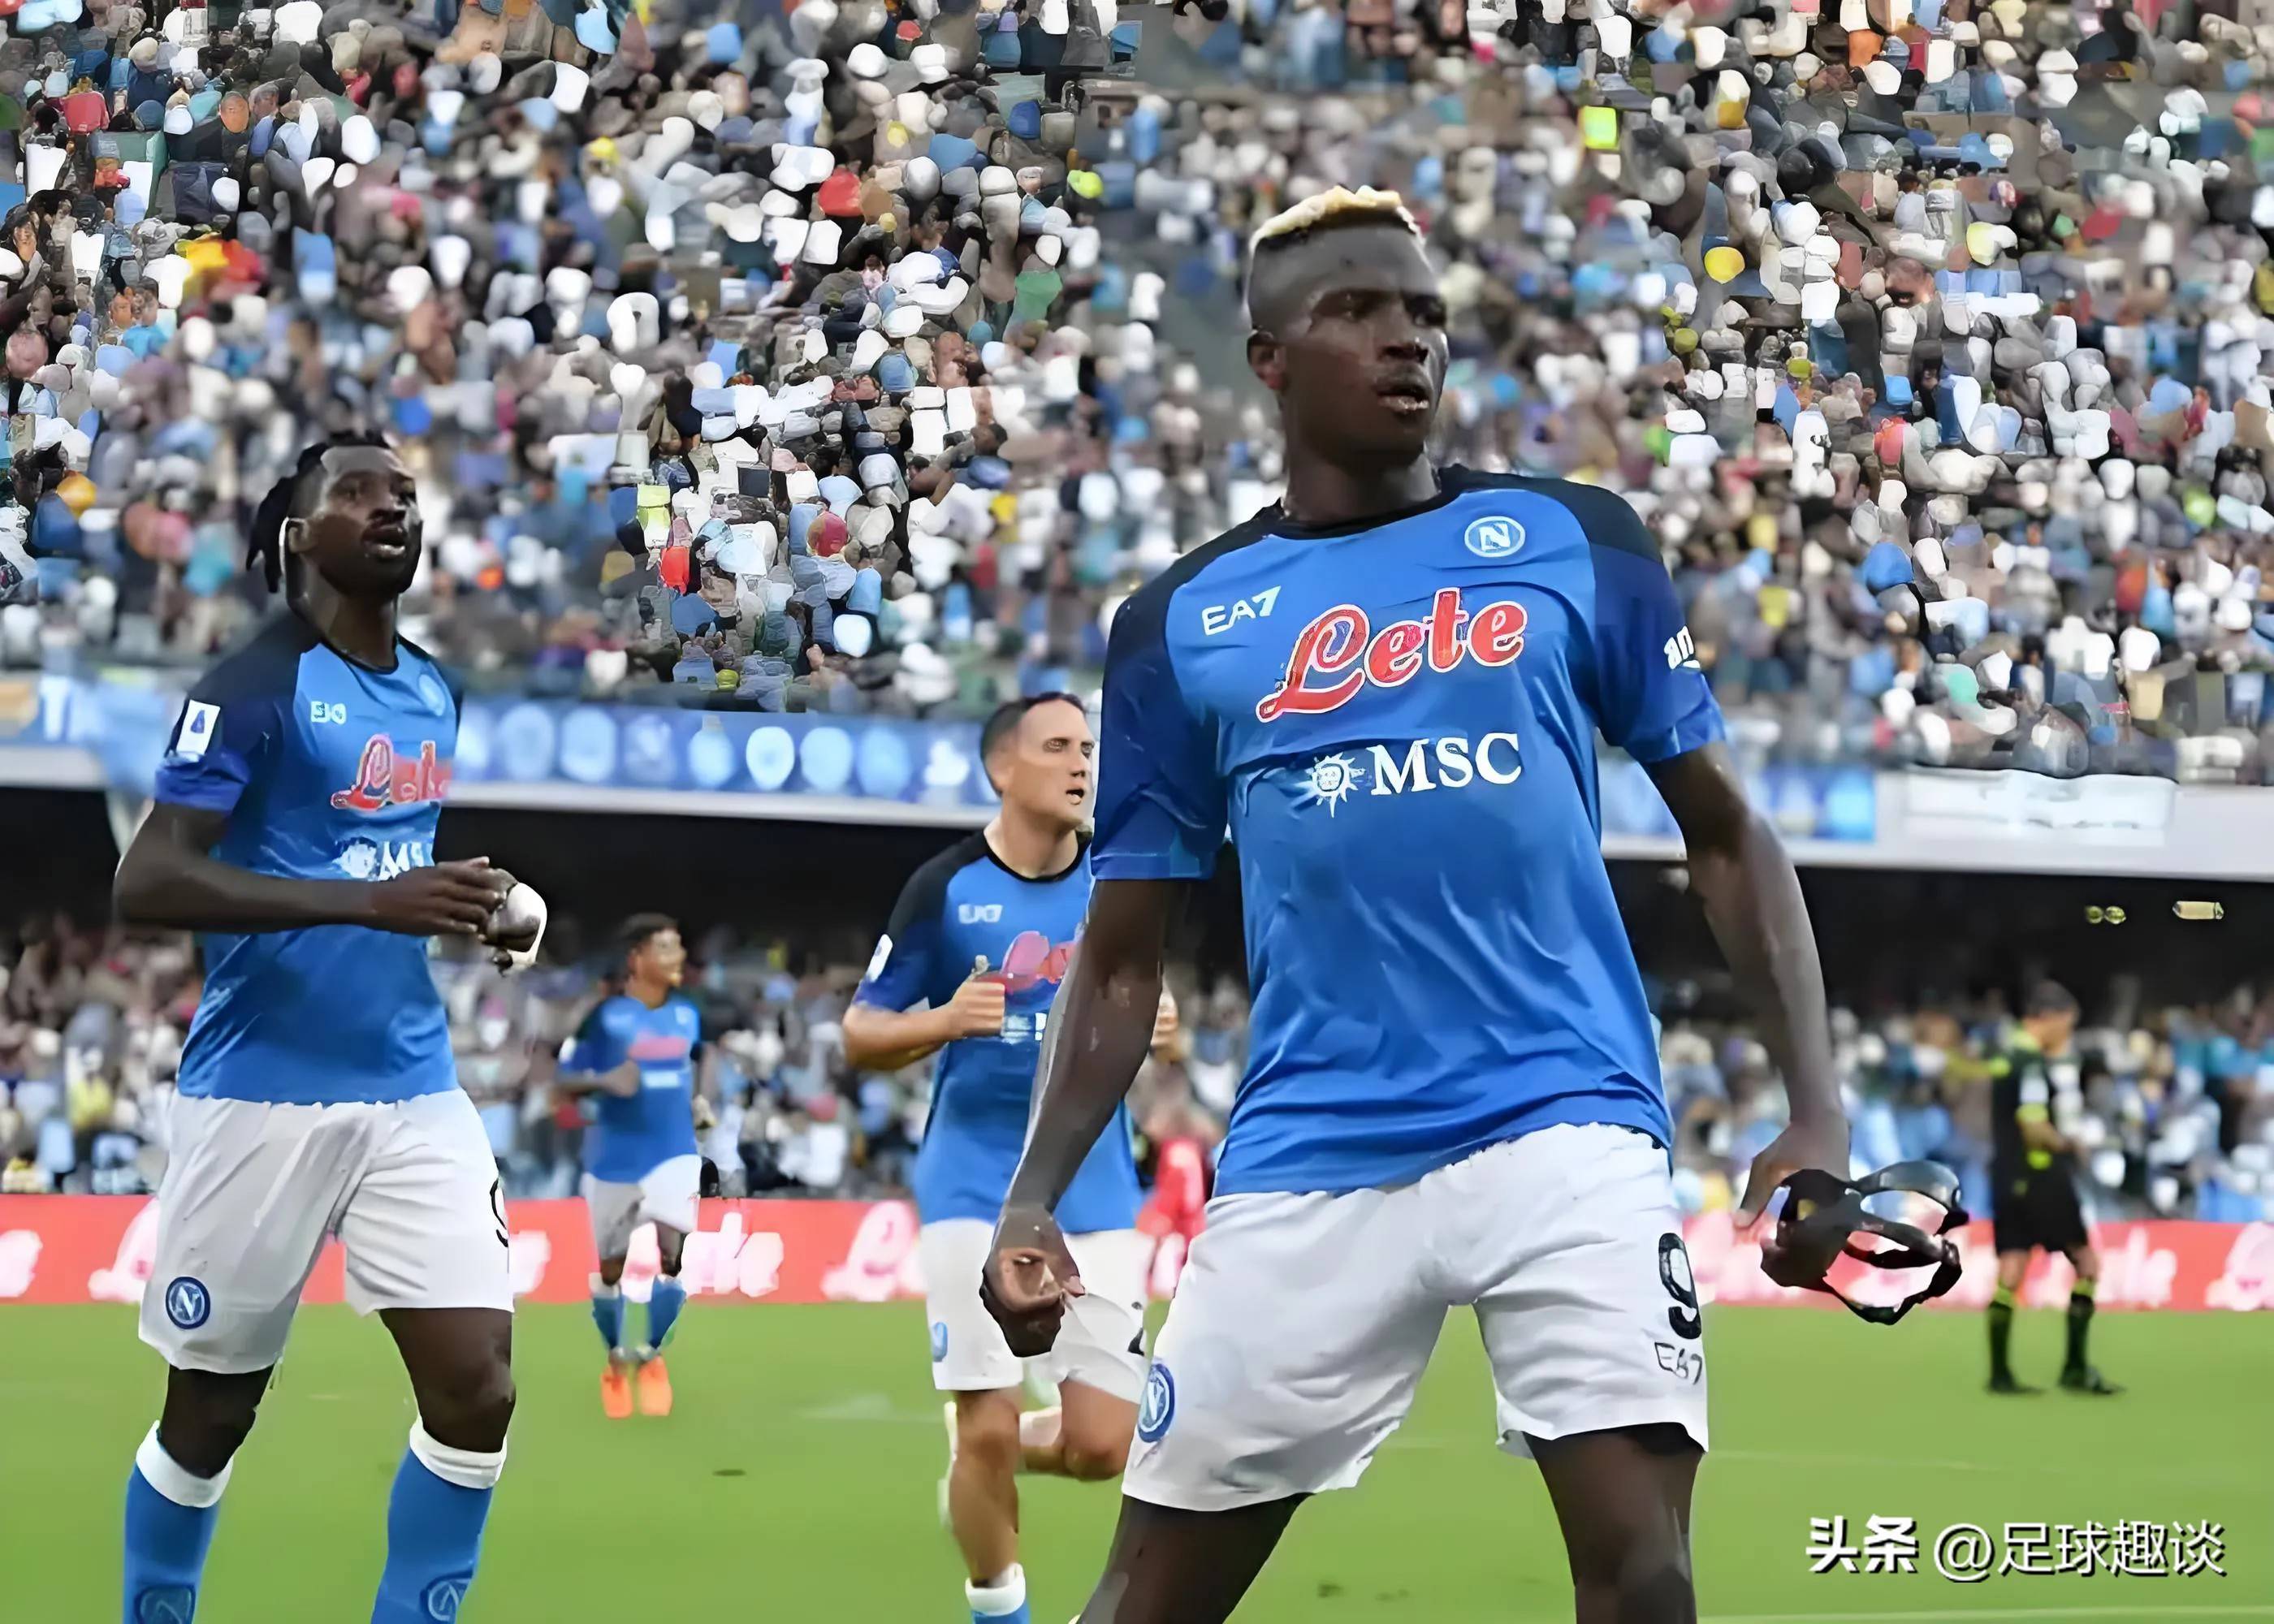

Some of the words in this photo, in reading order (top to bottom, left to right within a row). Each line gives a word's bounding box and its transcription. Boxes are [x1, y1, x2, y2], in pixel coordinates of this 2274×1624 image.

[1201, 585, 1282, 637] EA7
[1255, 586, 1528, 723] Lete
[1365, 732, 1522, 796] MSC
[1658, 1232, 1702, 1340] 9
